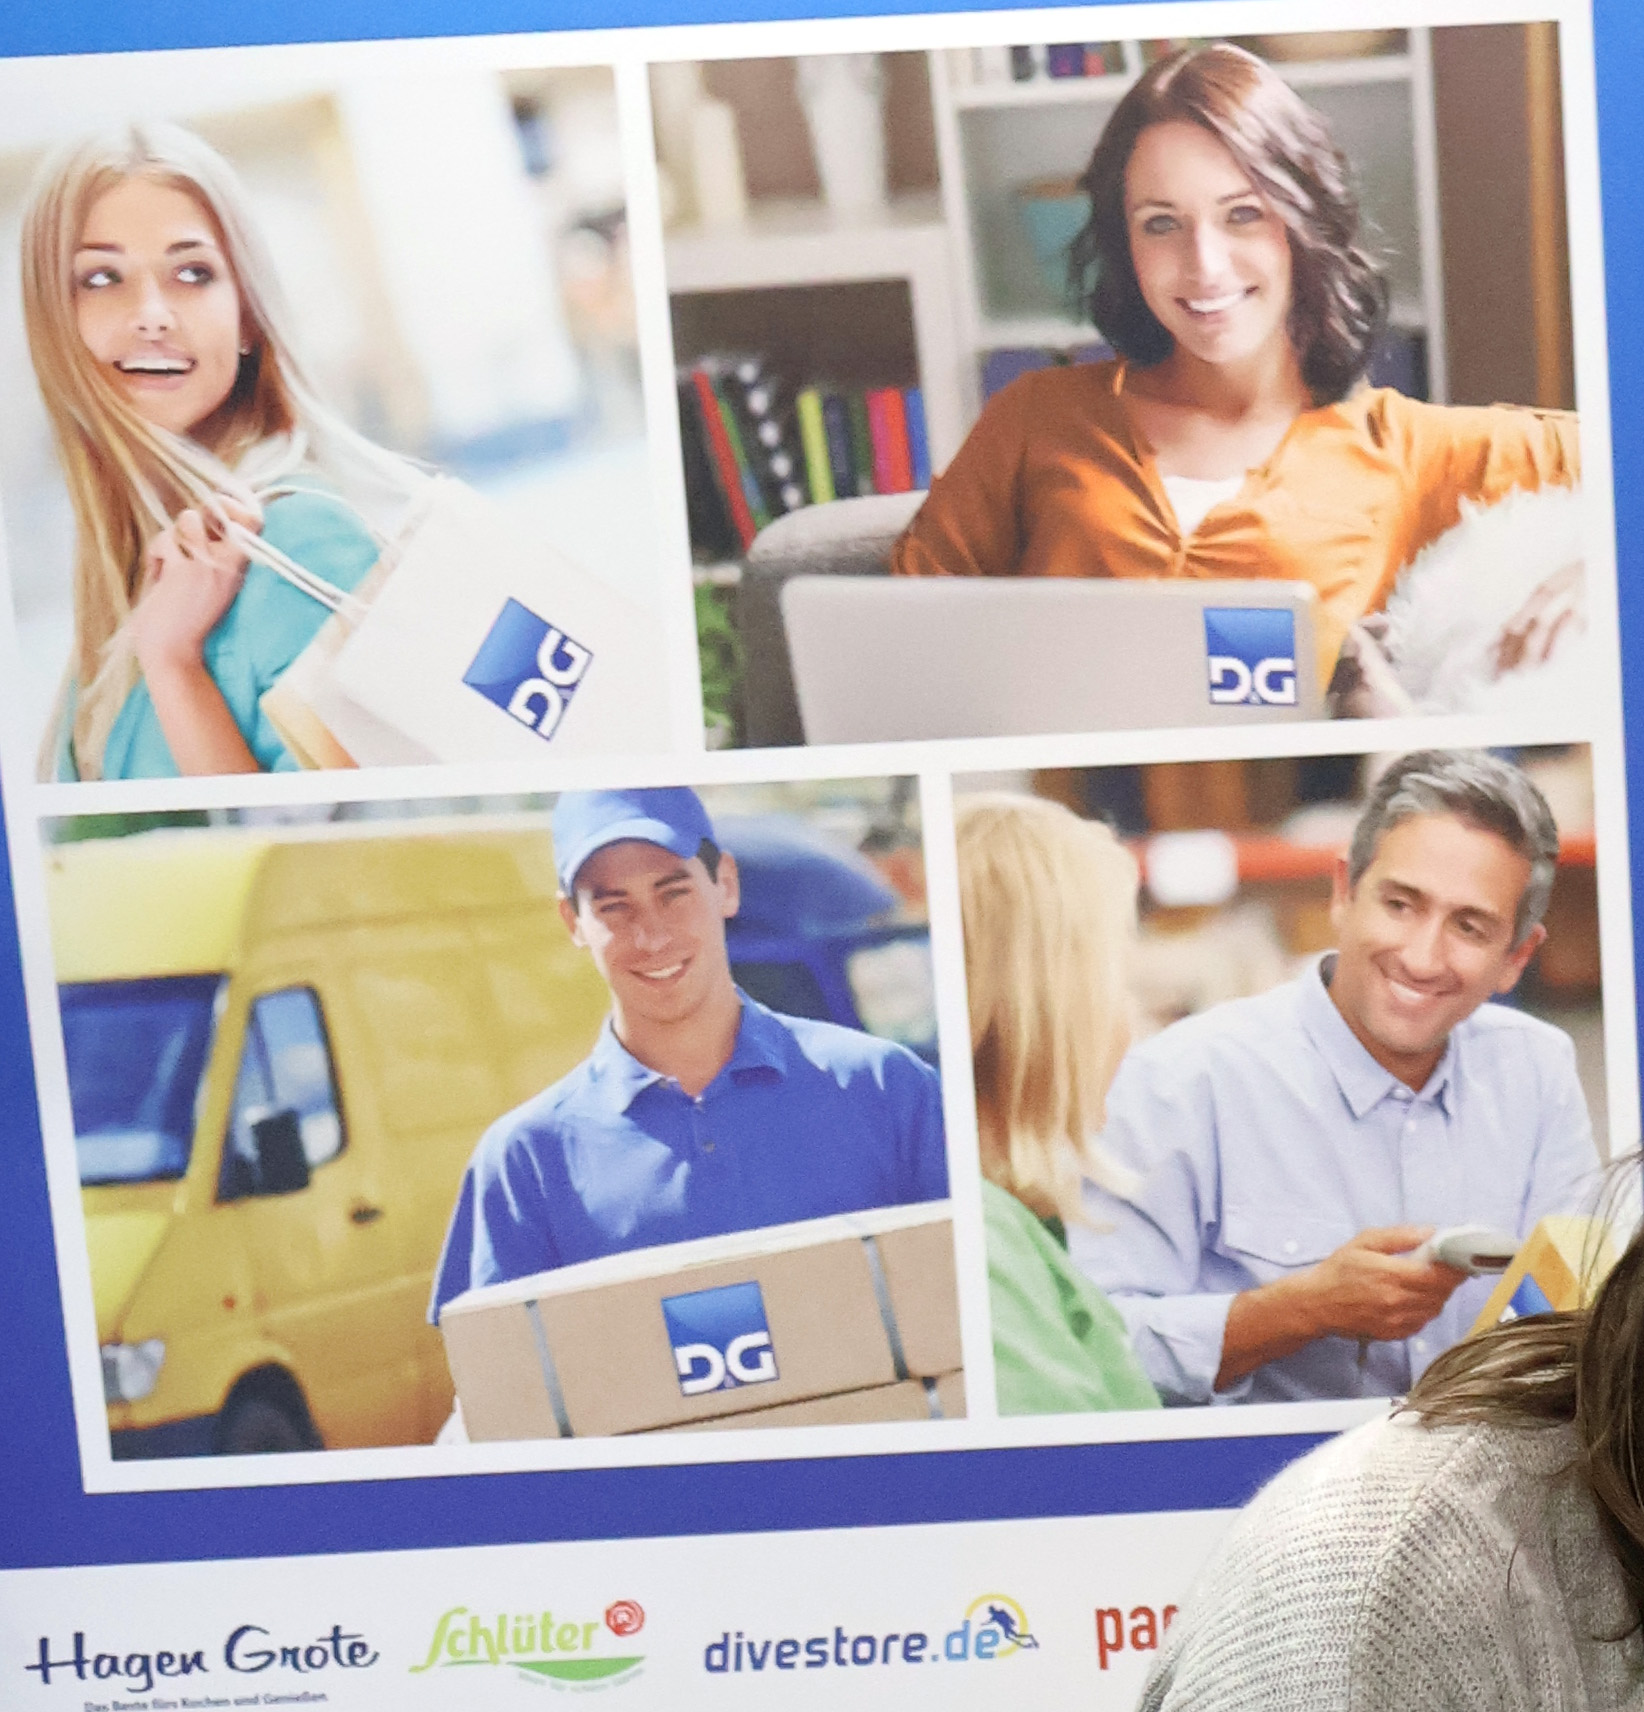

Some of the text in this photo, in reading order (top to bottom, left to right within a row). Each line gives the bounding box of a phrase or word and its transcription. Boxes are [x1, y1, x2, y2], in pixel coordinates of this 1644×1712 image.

[25, 1624, 380, 1692] Hagen Grote
[408, 1605, 599, 1674] Schlüter
[704, 1619, 1000, 1674] divestore.de
